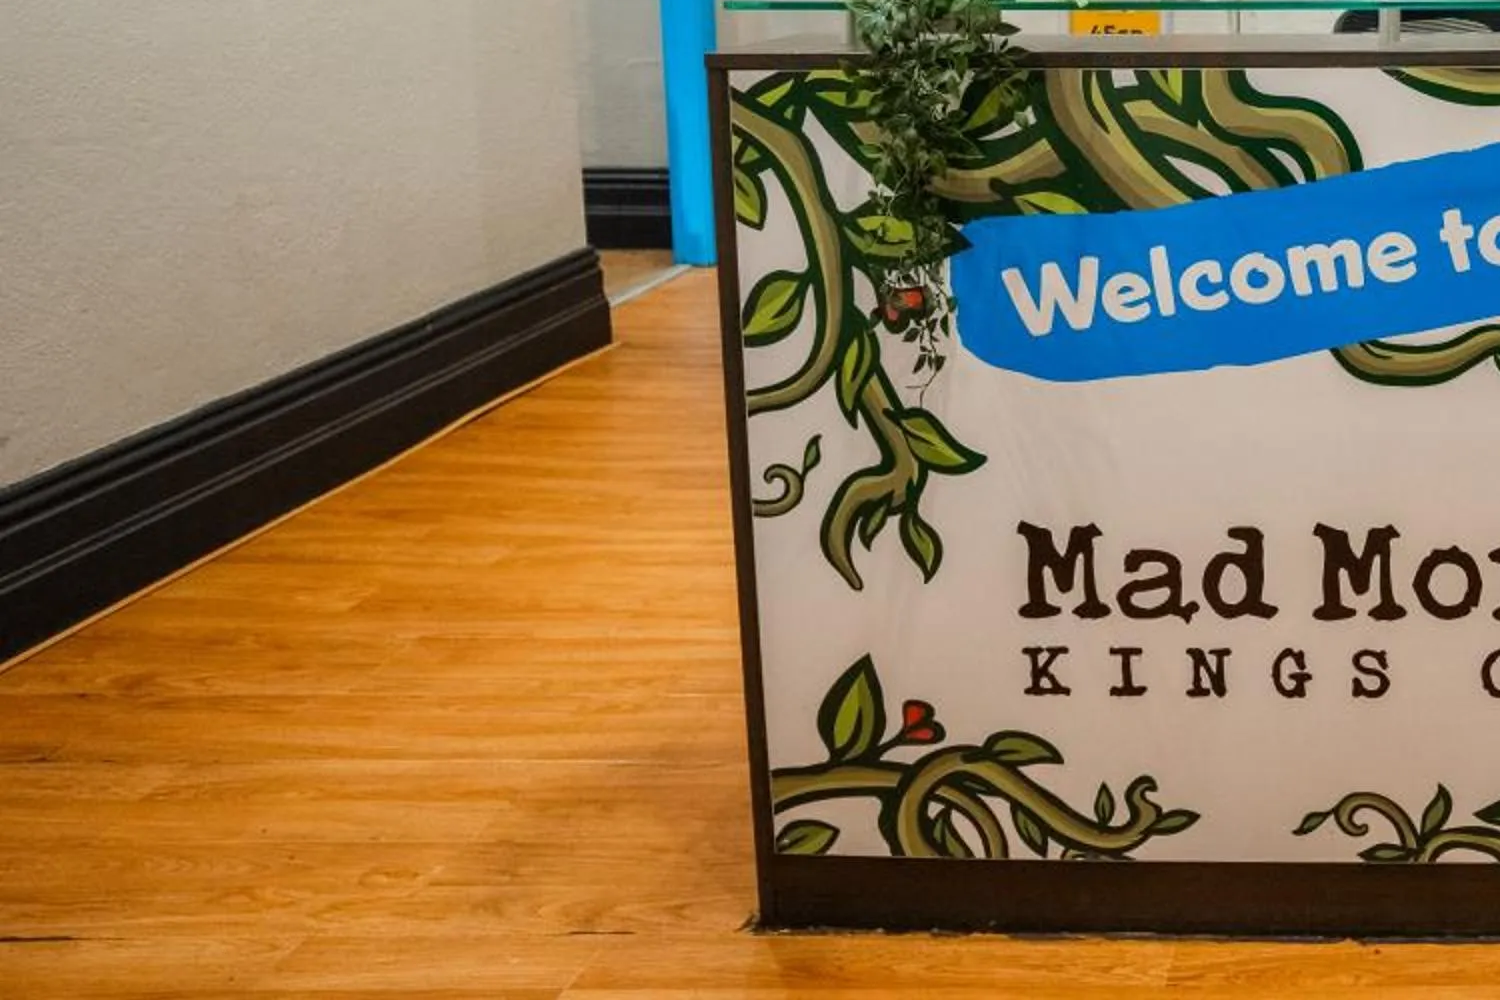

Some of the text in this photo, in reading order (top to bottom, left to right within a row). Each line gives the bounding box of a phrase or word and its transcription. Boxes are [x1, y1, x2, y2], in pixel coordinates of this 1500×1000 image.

[1001, 229, 1418, 338] Welcome
[1016, 520, 1280, 625] Mad
[1021, 646, 1392, 699] KINGS
